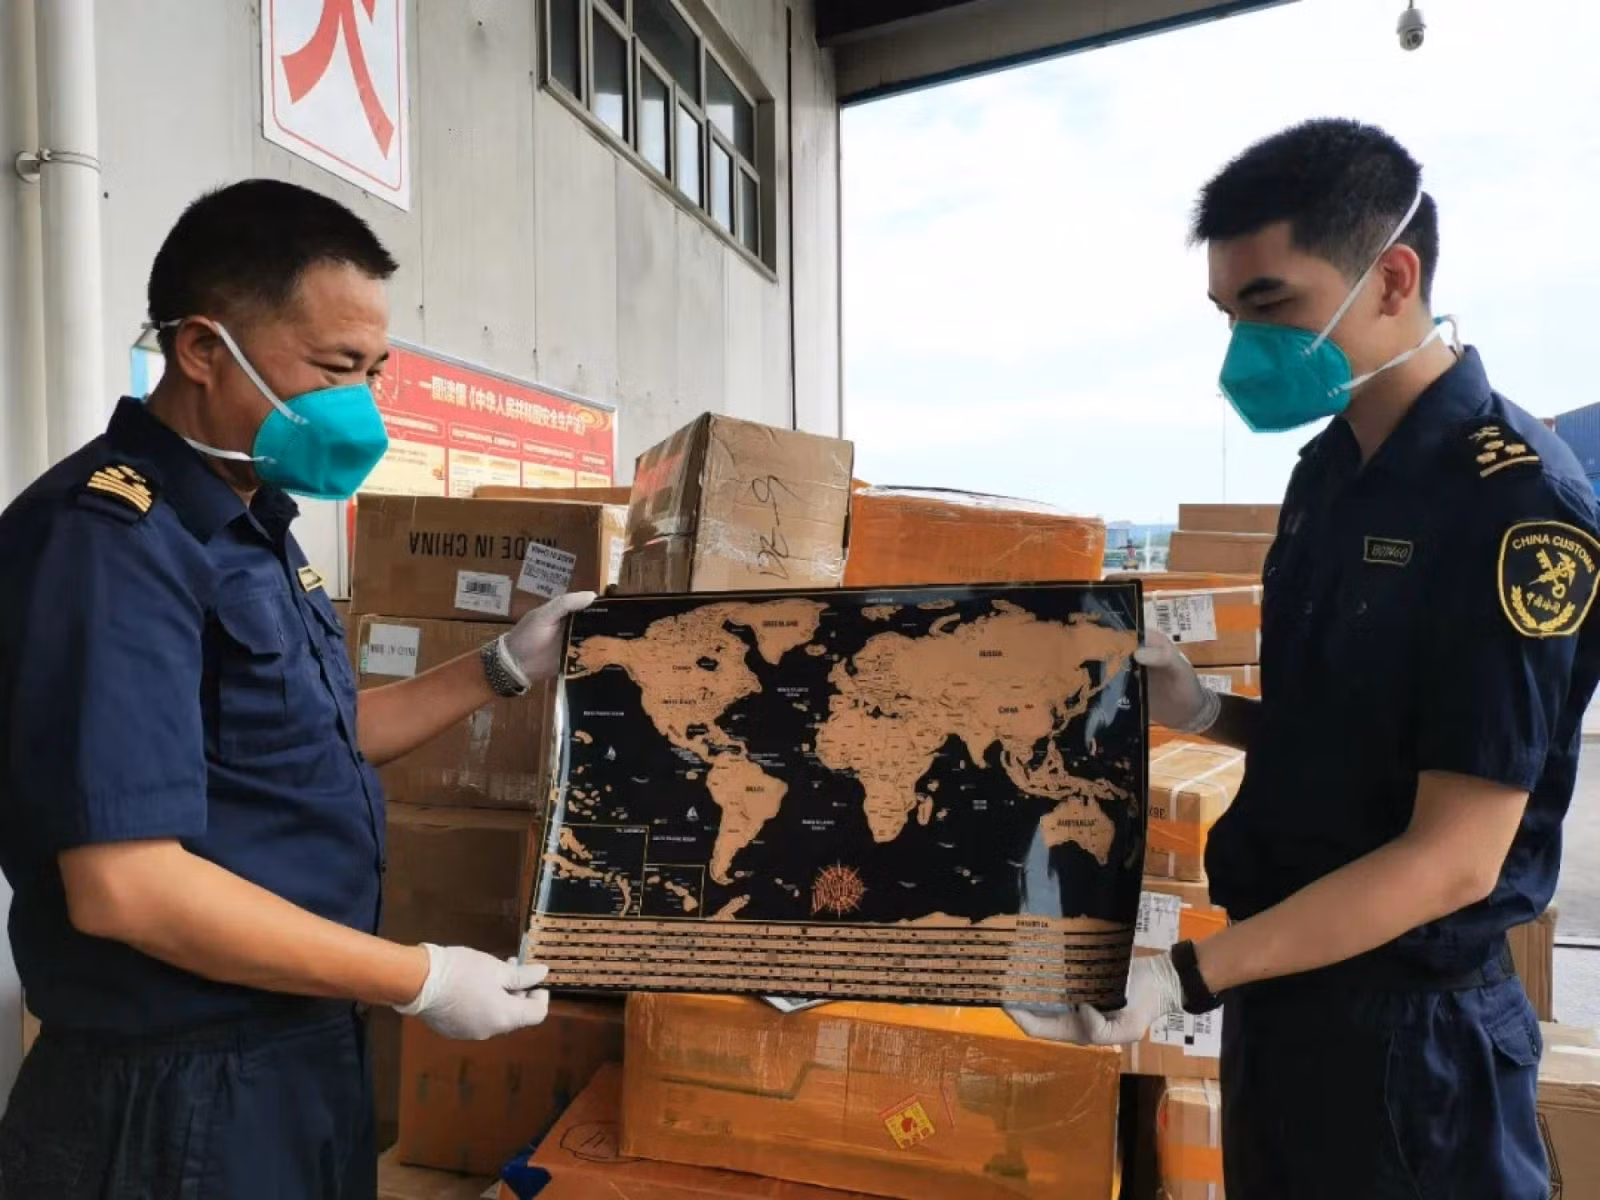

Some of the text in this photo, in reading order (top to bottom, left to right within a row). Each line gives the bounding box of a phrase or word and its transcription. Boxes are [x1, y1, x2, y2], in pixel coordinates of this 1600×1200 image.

[409, 531, 468, 558] CHINA
[475, 534, 494, 559] IN
[1512, 533, 1595, 574] CHINA CUSTOMS
